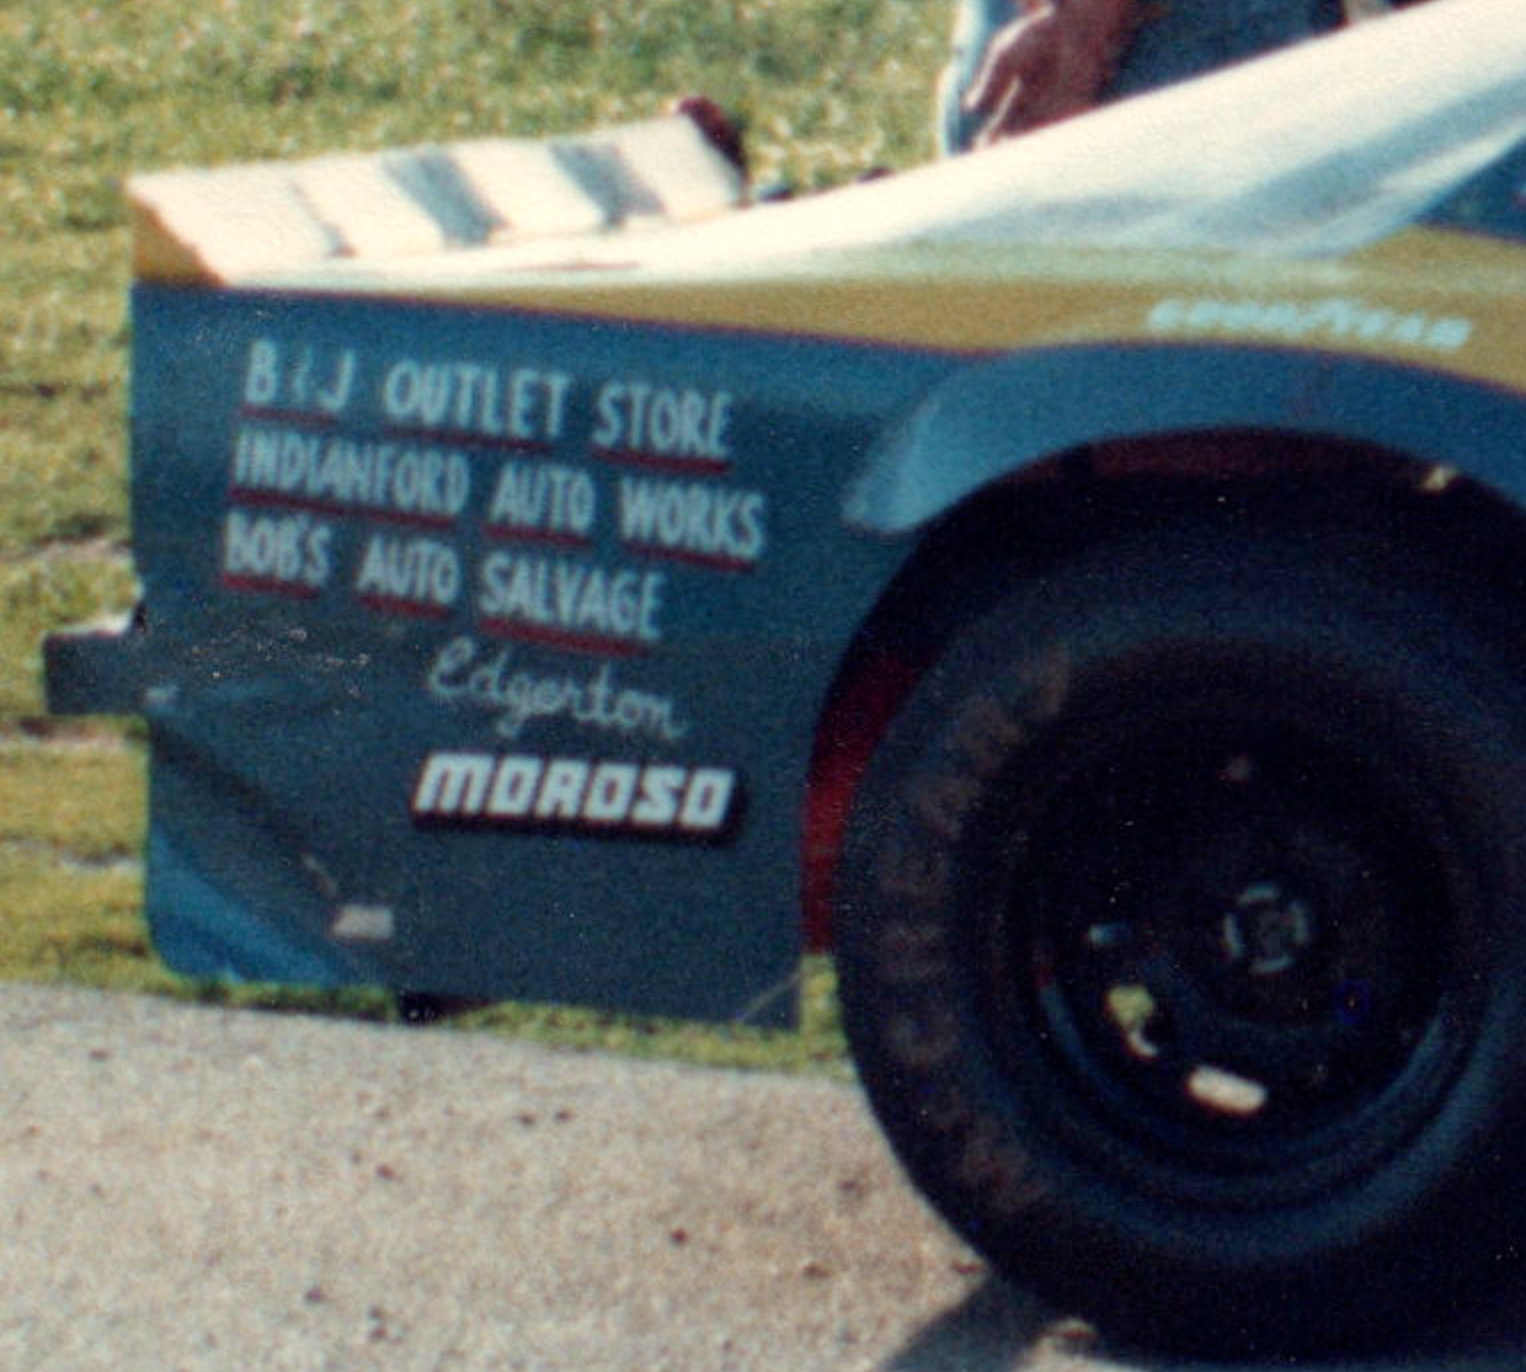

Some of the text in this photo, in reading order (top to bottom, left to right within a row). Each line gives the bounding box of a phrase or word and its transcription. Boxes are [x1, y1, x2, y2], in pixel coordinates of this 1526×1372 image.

[380, 356, 573, 439] OUTLET
[591, 378, 735, 460] STORE
[231, 425, 765, 560] INDIANFORD AUTO WORKS
[355, 531, 463, 604] AUTO
[477, 552, 666, 641] SALVAGE
[424, 636, 686, 740] Edgerton
[412, 750, 738, 829] MOROSO
